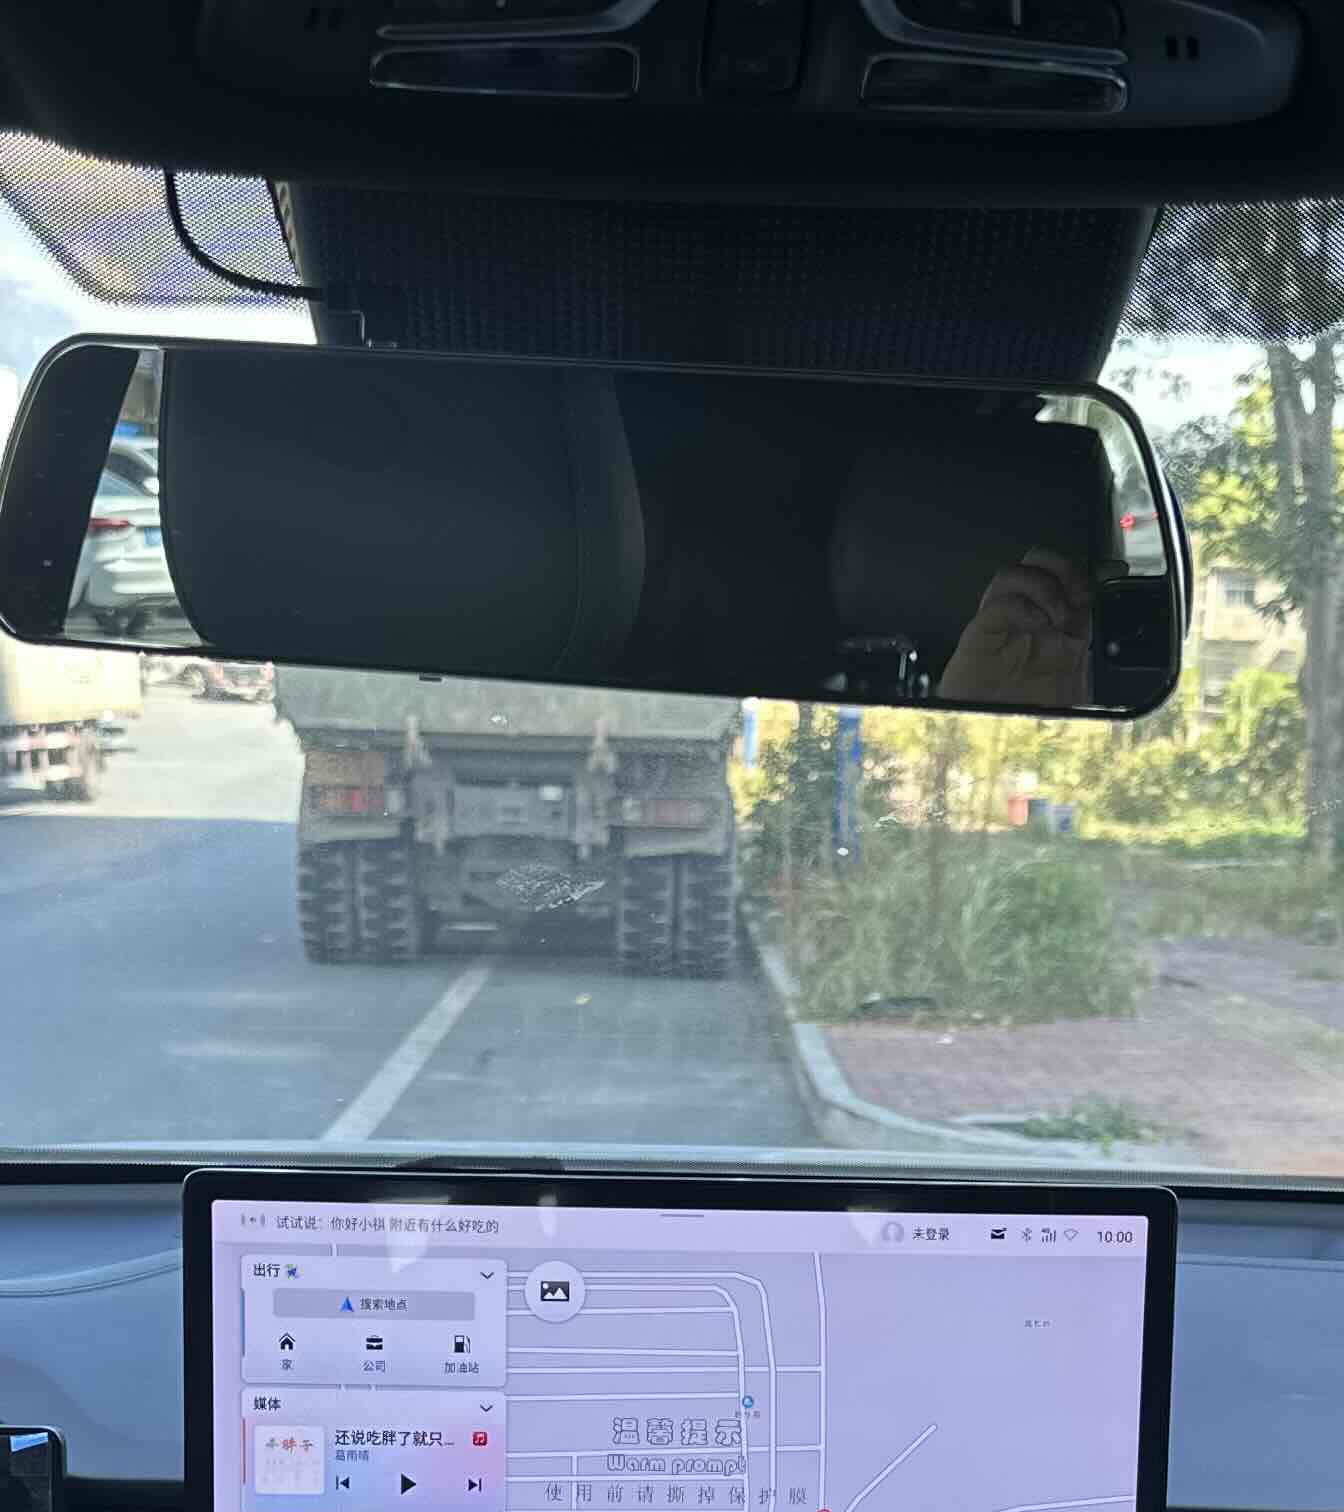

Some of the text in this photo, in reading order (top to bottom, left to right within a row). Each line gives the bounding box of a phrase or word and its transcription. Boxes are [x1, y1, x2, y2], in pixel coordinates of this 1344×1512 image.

[912, 1227, 950, 1241] 未登录
[1097, 1230, 1133, 1244] 10:00
[253, 1263, 280, 1278] 出行
[360, 1299, 408, 1312] 搜索地点
[281, 1359, 293, 1371] 家
[363, 1360, 386, 1373] 公司
[444, 1361, 479, 1375] 加油站
[253, 1396, 281, 1412] 媒体
[611, 1416, 745, 1446] 温馨提示
[607, 1454, 746, 1475] Warm prompt
